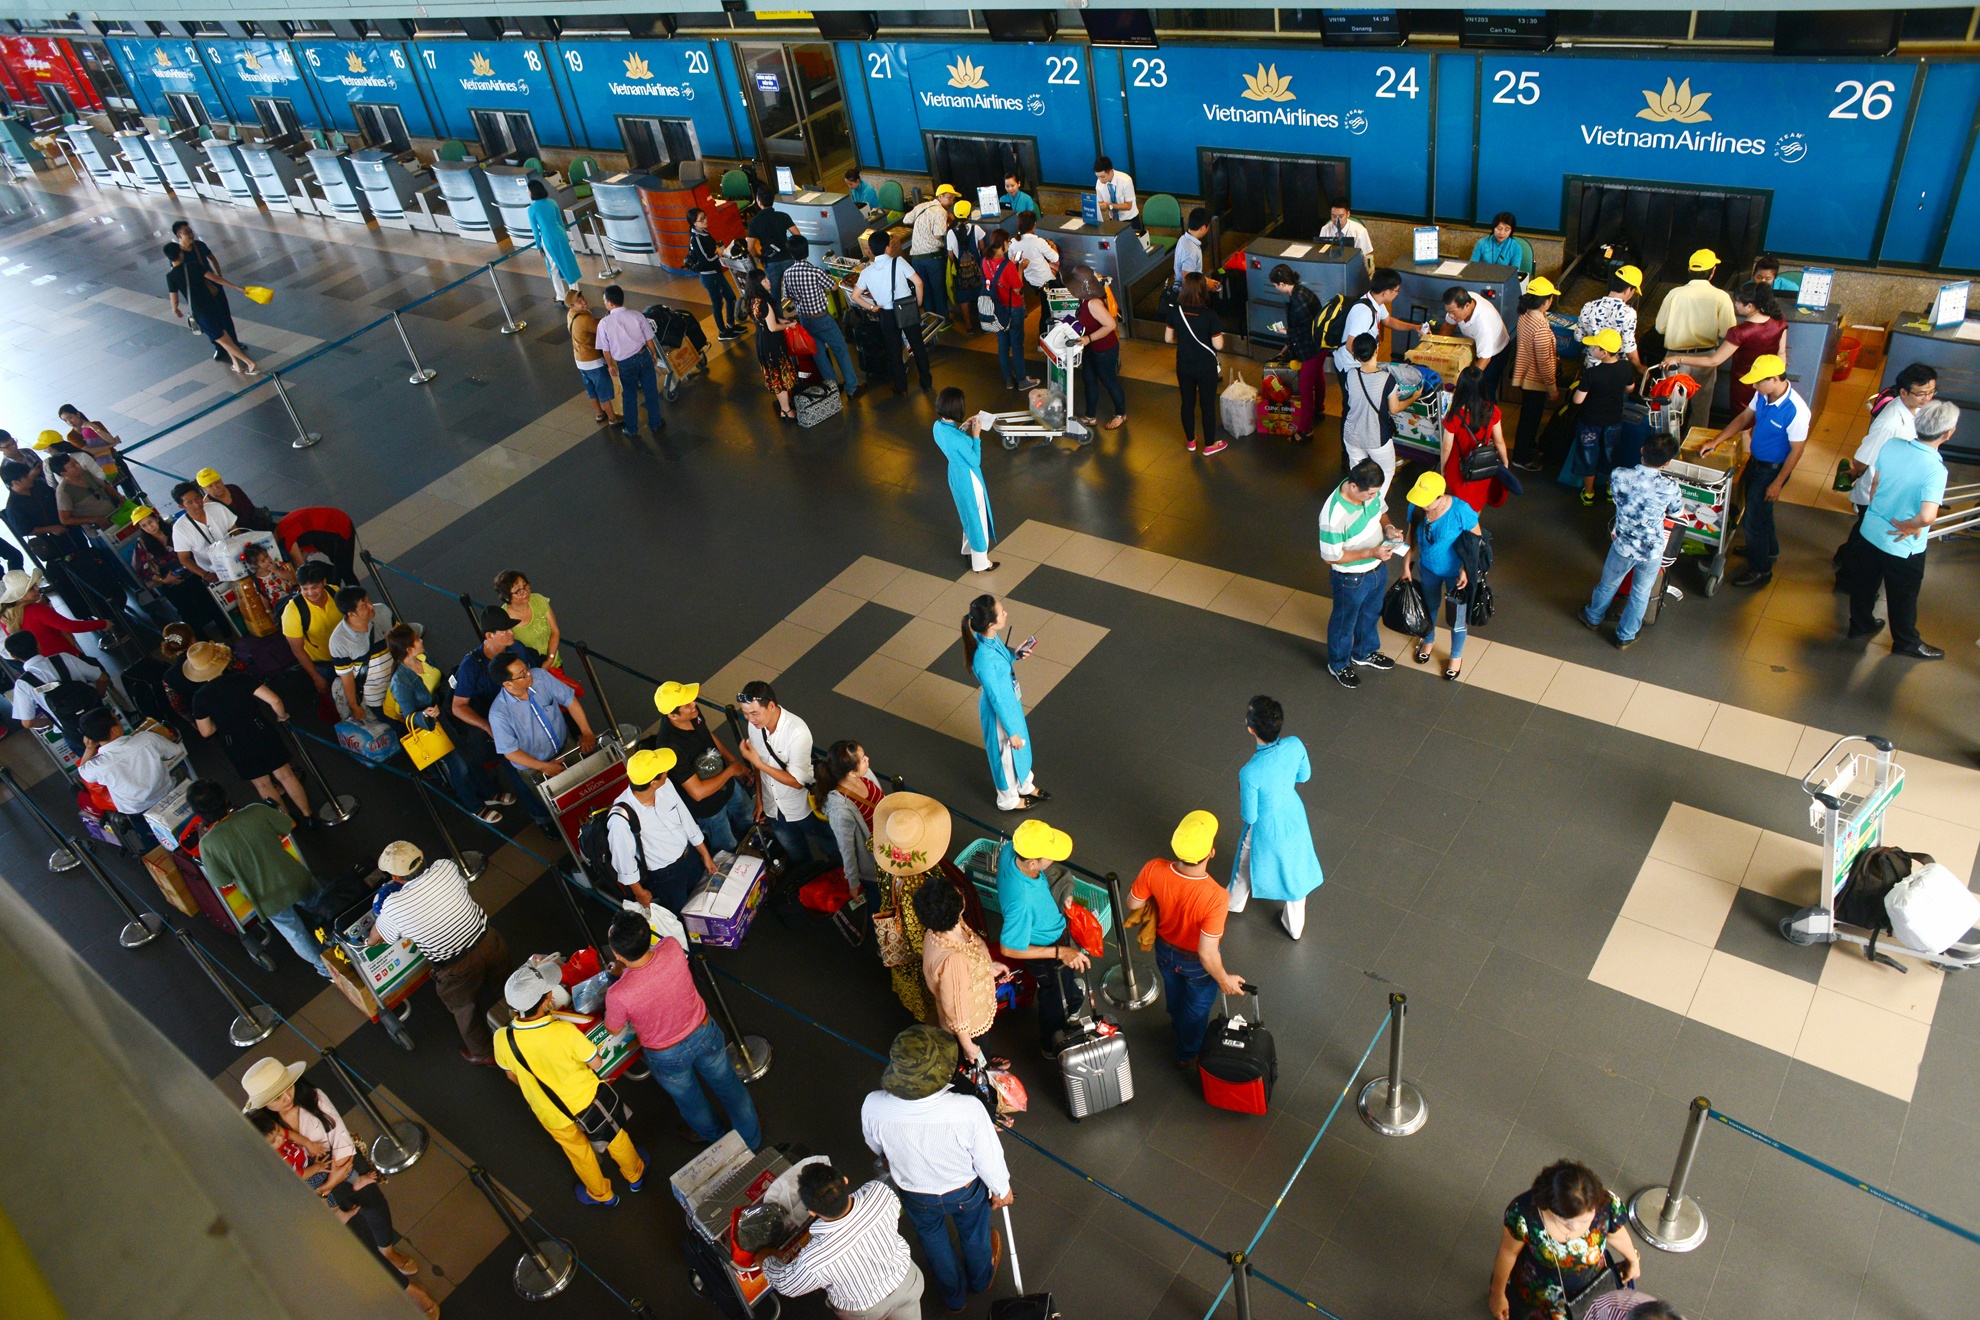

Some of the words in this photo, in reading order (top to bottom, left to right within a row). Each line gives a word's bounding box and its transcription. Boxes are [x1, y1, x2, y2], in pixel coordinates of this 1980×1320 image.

[123, 45, 135, 61] 11
[185, 46, 199, 63] 12
[207, 47, 221, 64] 13
[278, 48, 293, 66] 14
[305, 48, 320, 67] 15
[389, 49, 405, 69] 16
[423, 50, 437, 70] 17
[523, 50, 542, 72] 18
[564, 50, 584, 72] 19
[685, 50, 709, 74] 20
[868, 53, 892, 79] 21
[1045, 56, 1080, 85] 22
[1131, 57, 1168, 88] 23
[1375, 65, 1420, 99] 24
[1492, 69, 1541, 105] 25
[1828, 80, 1896, 120] 26
